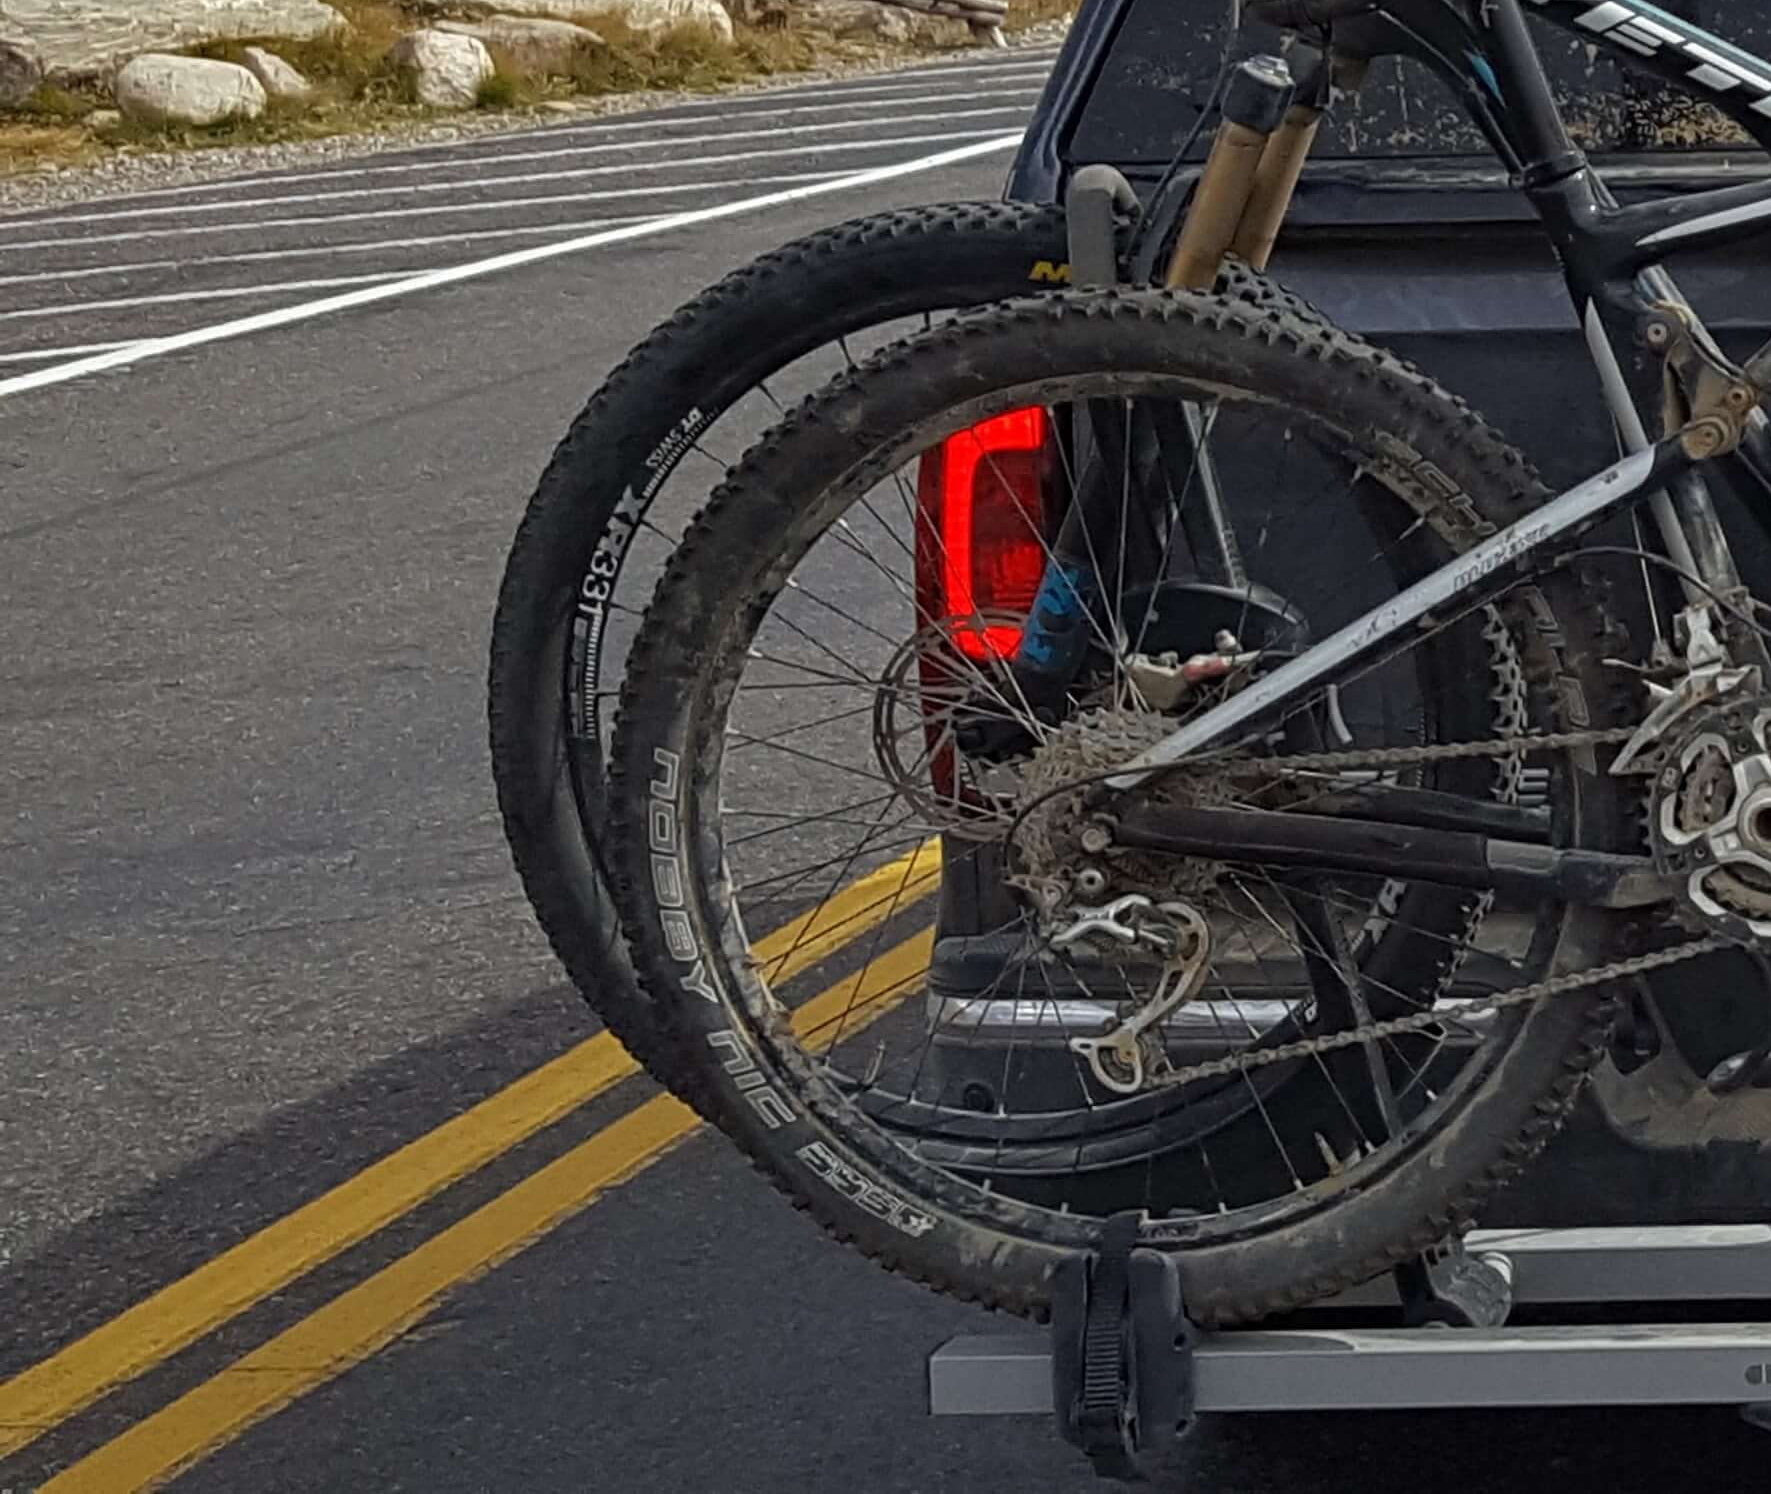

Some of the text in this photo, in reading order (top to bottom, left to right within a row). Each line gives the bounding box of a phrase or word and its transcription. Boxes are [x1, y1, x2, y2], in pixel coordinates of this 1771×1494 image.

[681, 407, 702, 433] DT
[577, 483, 649, 616] XR331
[649, 747, 797, 1130] NOBBY NIC
